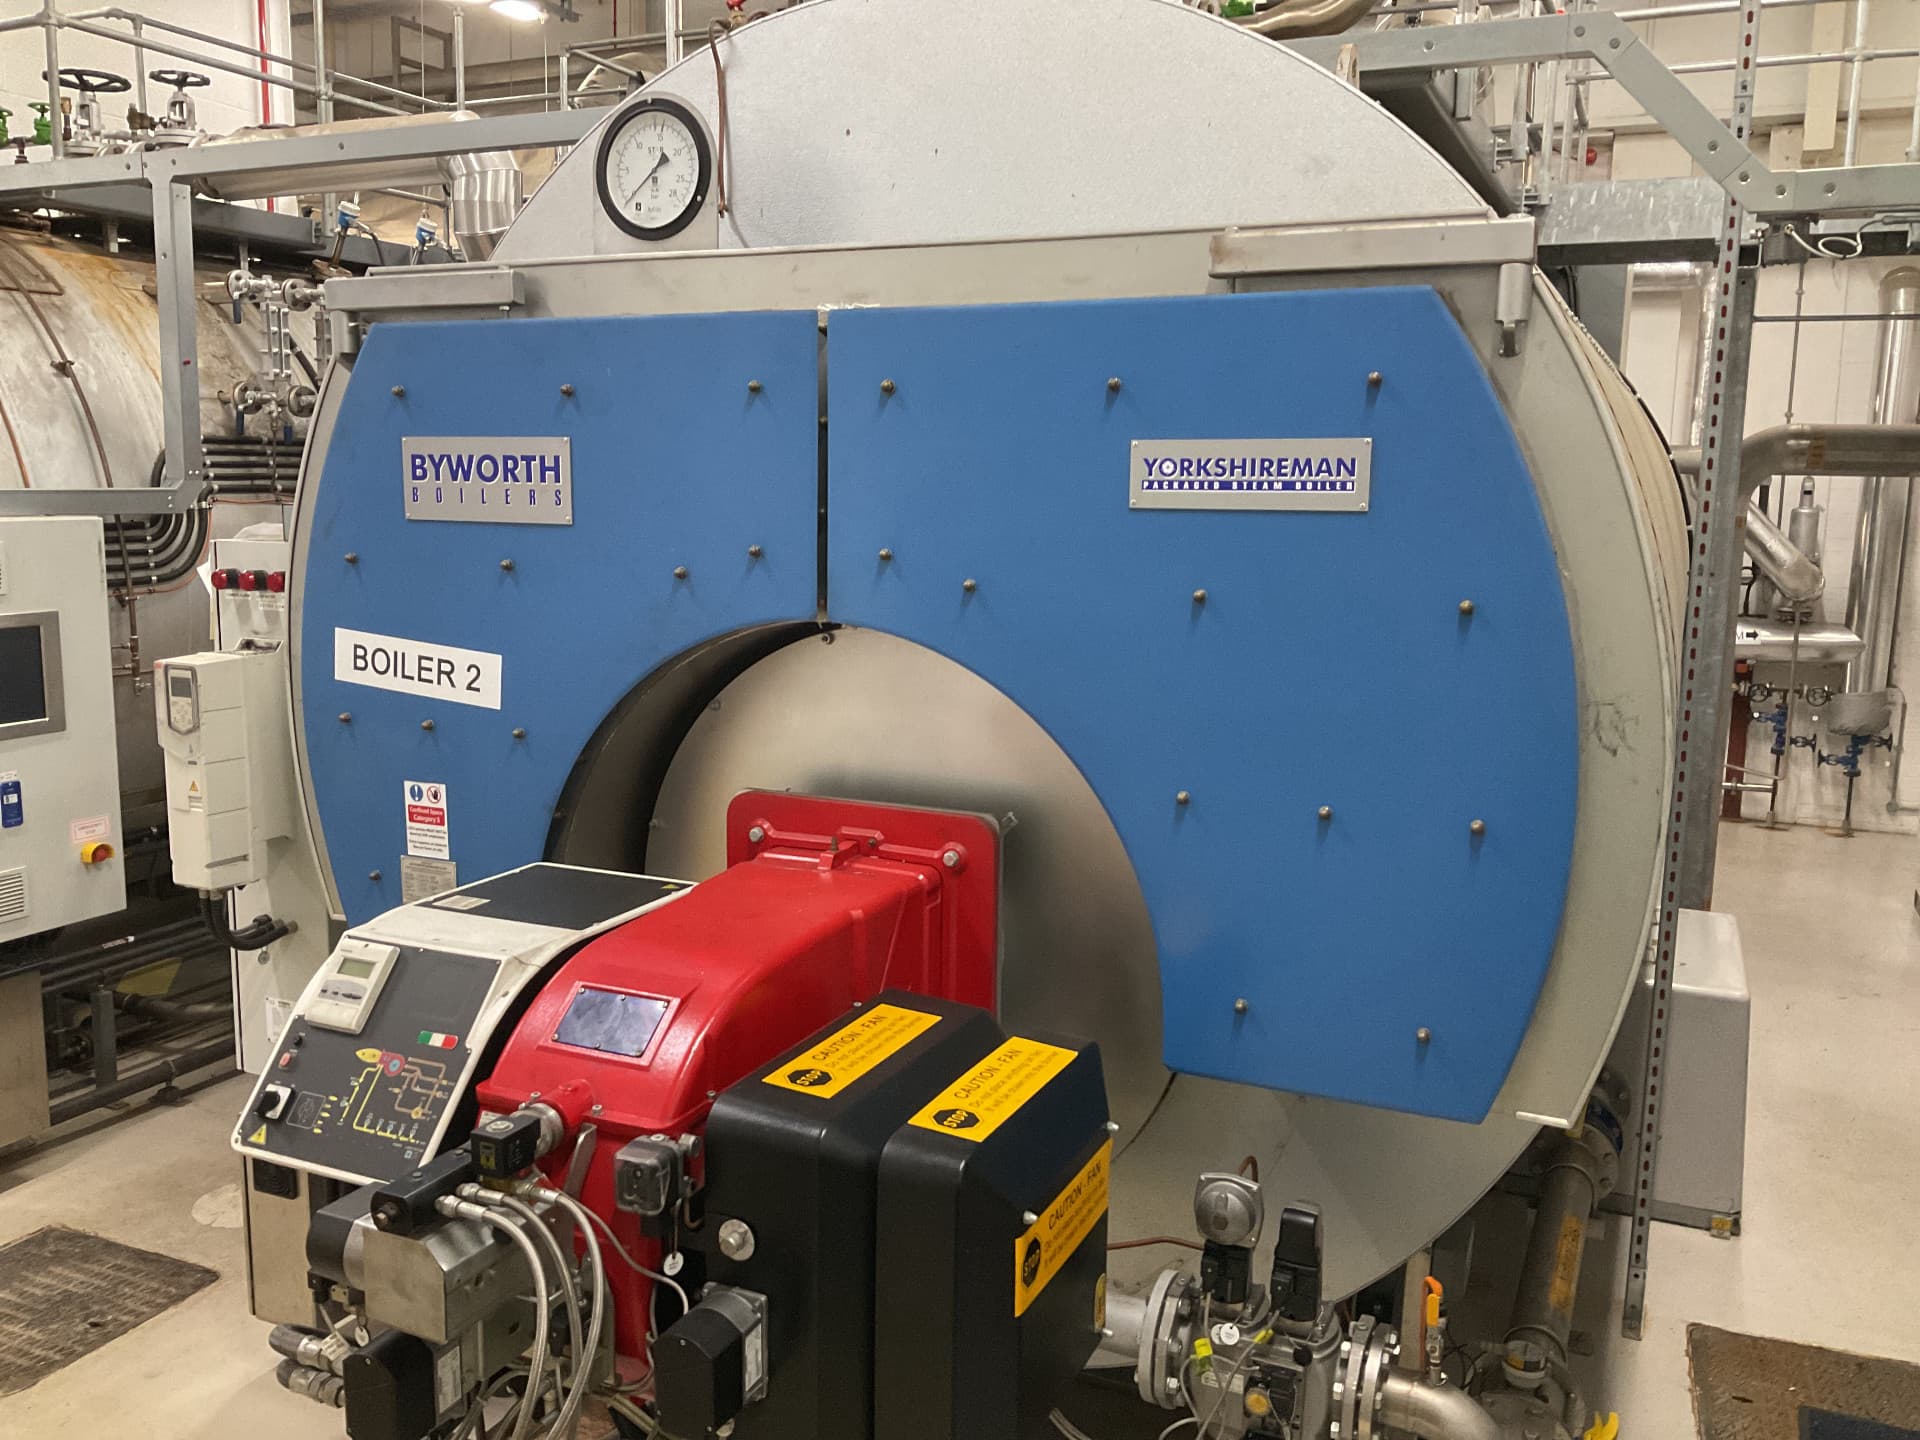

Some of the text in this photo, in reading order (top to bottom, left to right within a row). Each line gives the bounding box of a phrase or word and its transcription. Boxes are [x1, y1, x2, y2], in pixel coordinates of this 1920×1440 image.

[411, 453, 561, 483] BYWORTH
[1143, 457, 1356, 477] YORKSHIREMAN
[412, 487, 562, 506] BOILERS
[1143, 481, 1353, 490] PACKAGED STEAM BOILER
[353, 643, 481, 692] BOILER 2
[812, 1030, 862, 1061] CAUTION
[861, 1014, 888, 1030] FAN
[796, 1069, 822, 1086] STOP
[954, 1065, 1000, 1099] CAUTION
[998, 1049, 1023, 1065] FAN
[943, 1110, 969, 1128] STOP
[1048, 1183, 1082, 1230] CAUTION
[1087, 1160, 1102, 1183] FAN
[1024, 1248, 1040, 1277] STOP
